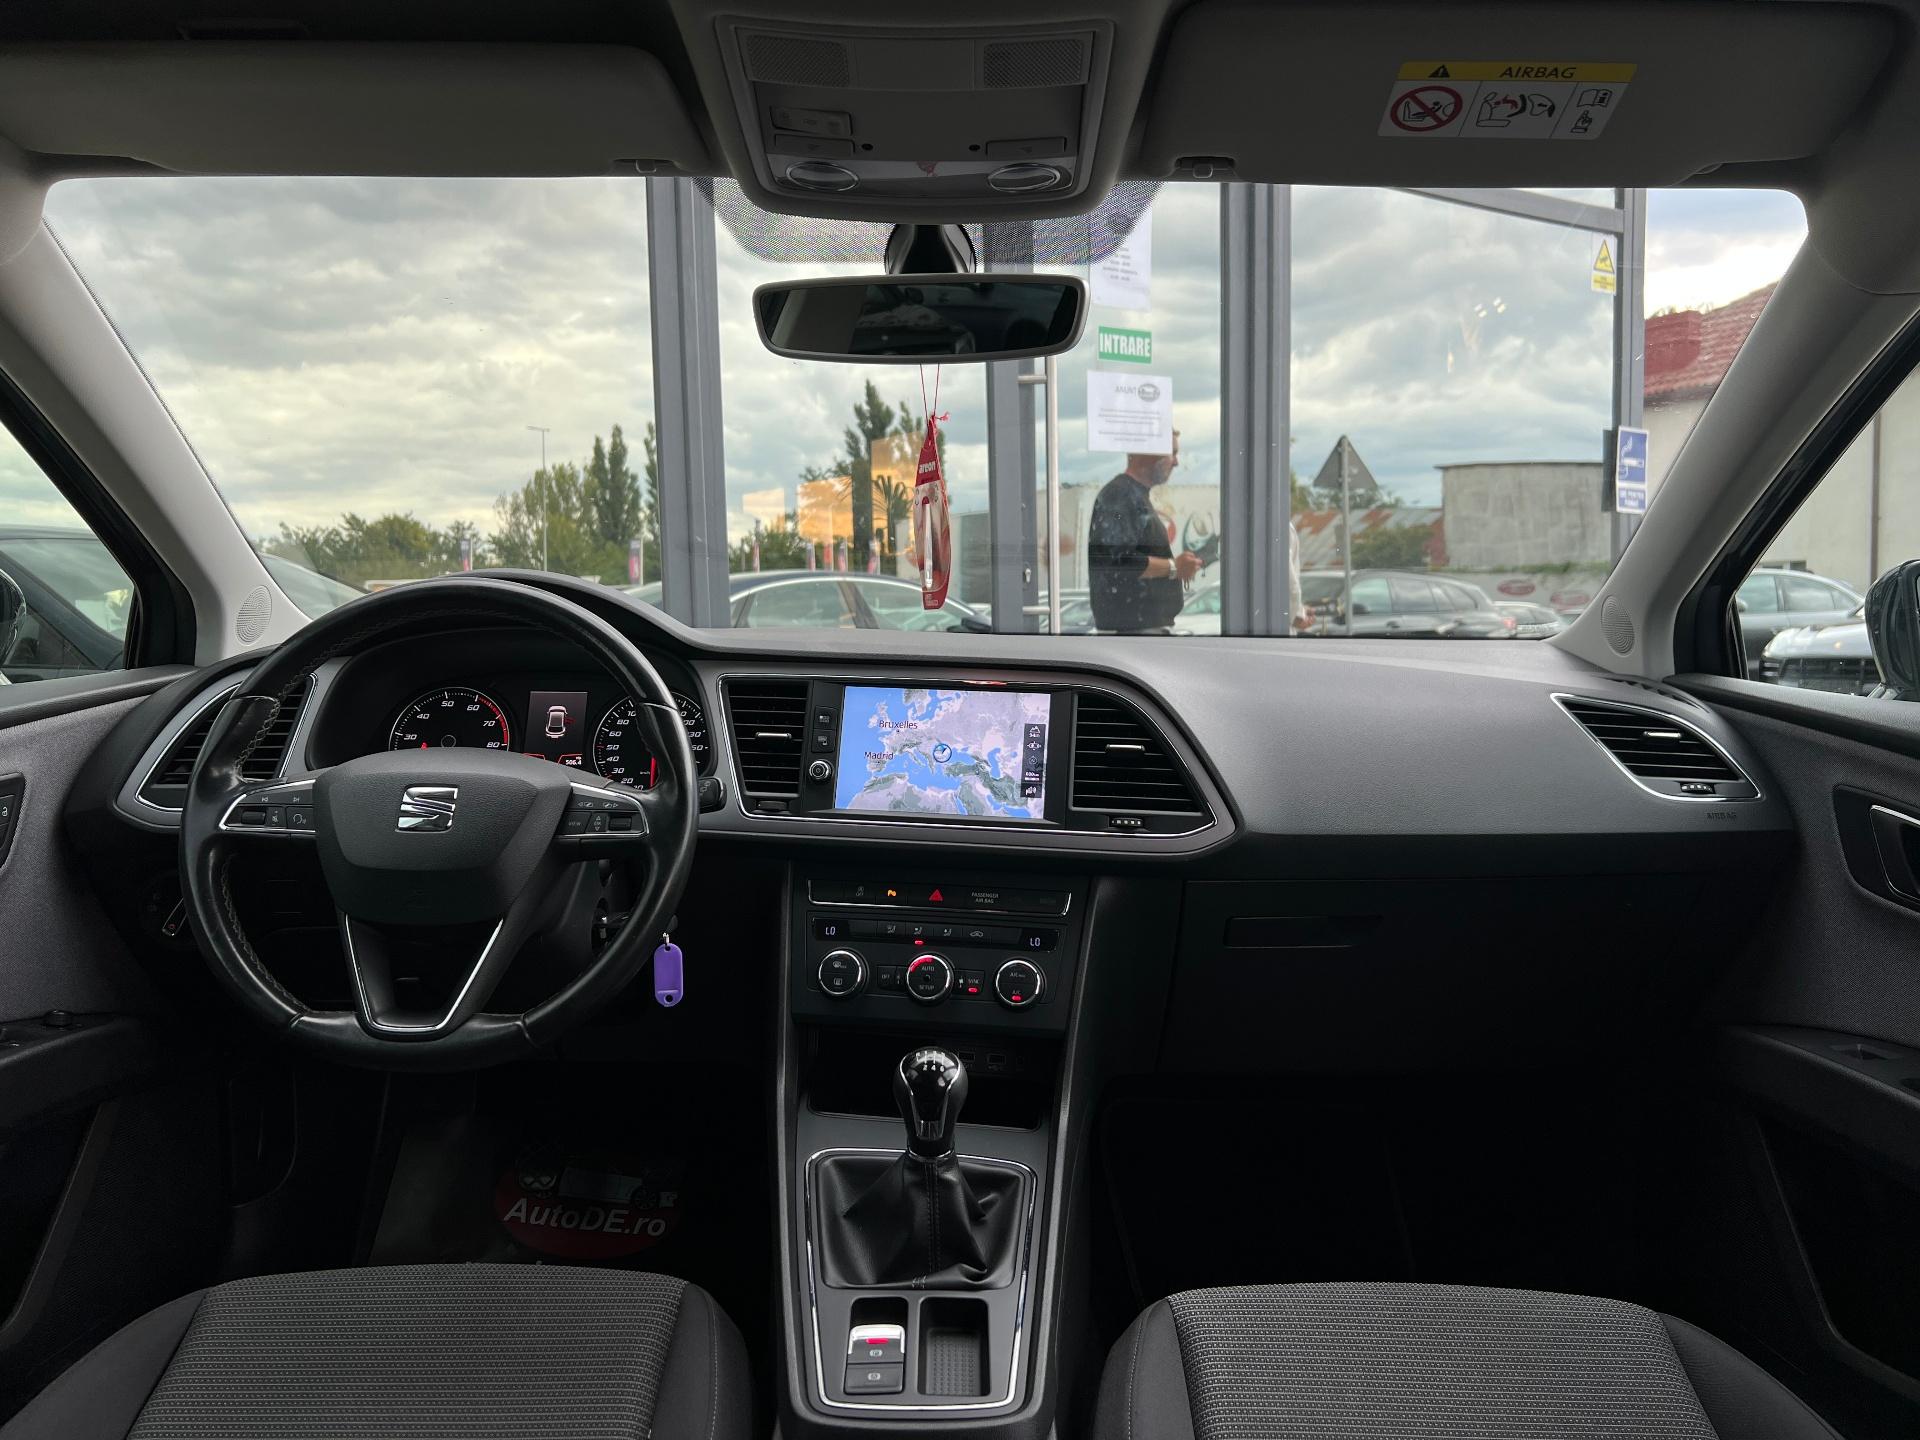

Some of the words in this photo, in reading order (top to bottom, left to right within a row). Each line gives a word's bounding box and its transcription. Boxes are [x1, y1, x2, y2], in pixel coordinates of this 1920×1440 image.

[1499, 67, 1577, 79] AIRBAG
[1099, 333, 1151, 357] INTRARE
[918, 460, 936, 474] areon
[878, 720, 918, 730] Bruxelles
[864, 751, 894, 761] Madrid
[971, 891, 999, 899] PASSENGER
[503, 1197, 667, 1237] AutoDE.ro
